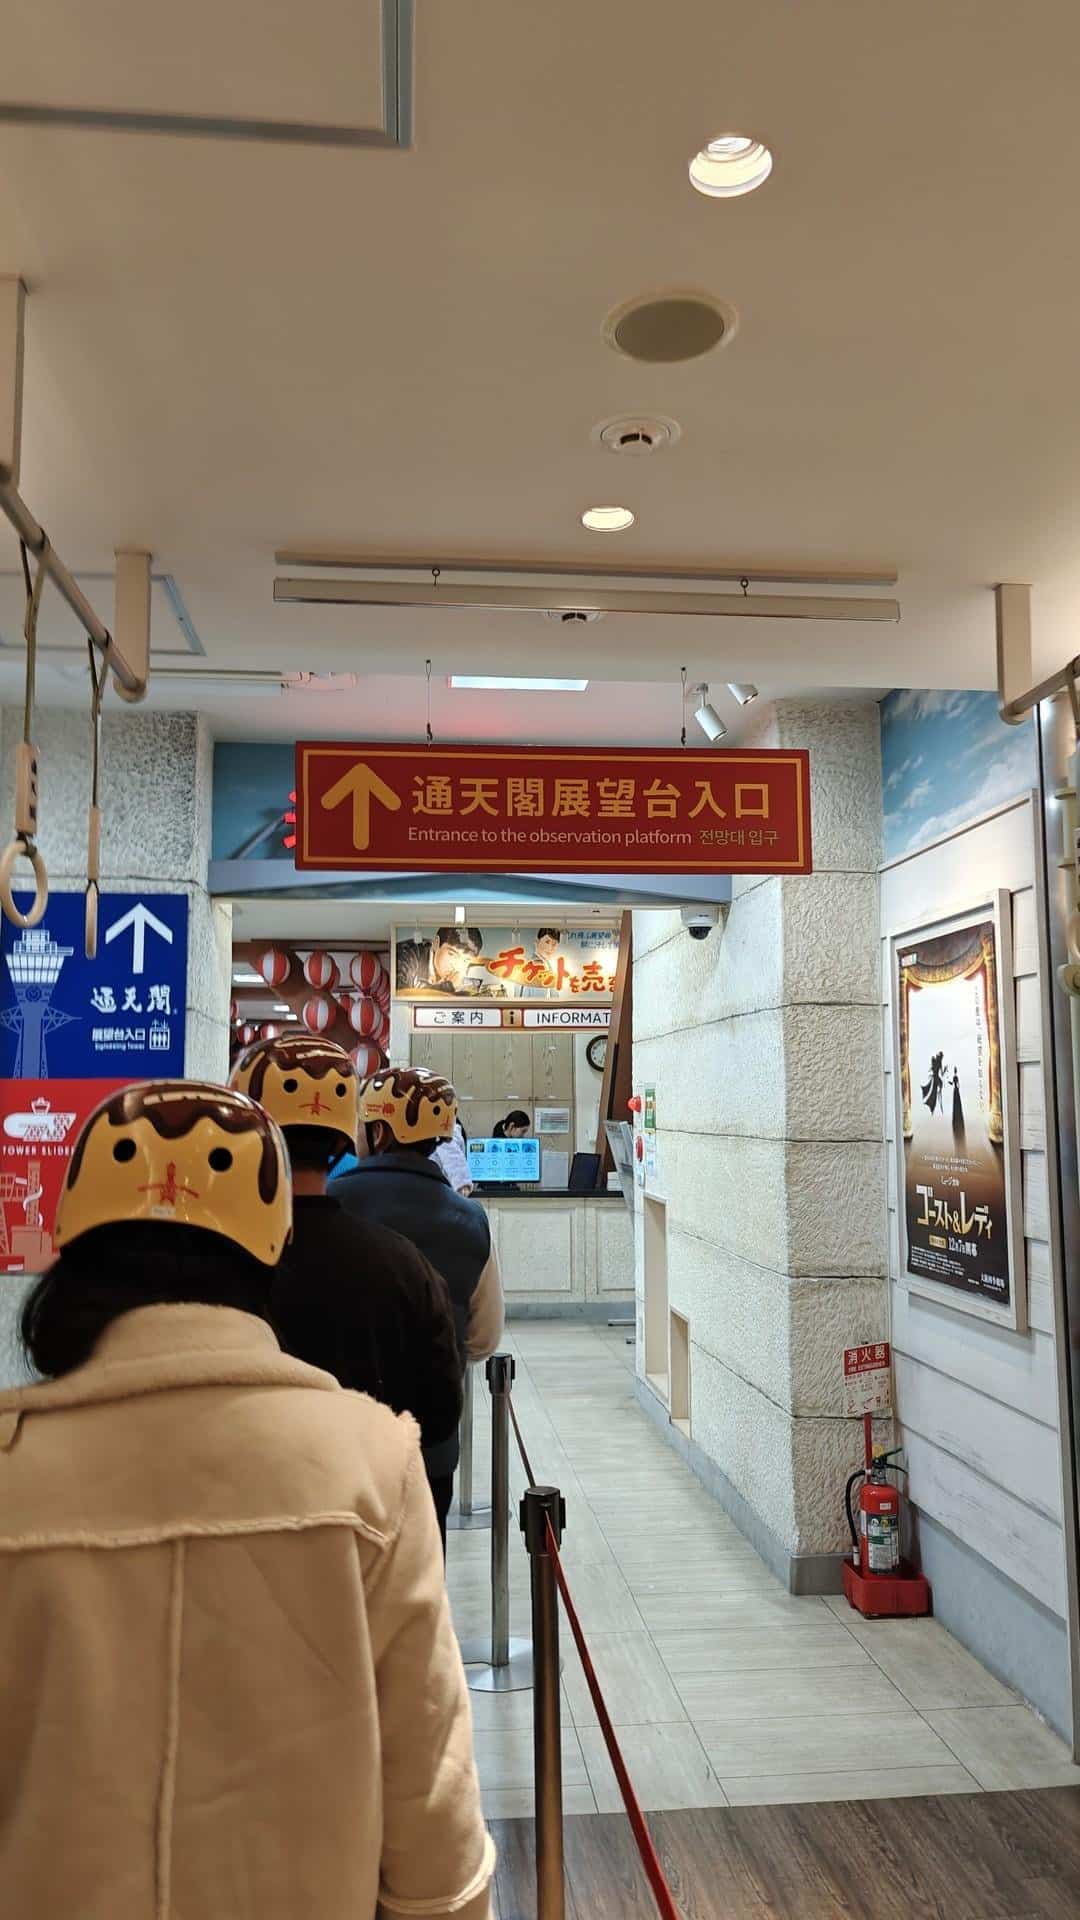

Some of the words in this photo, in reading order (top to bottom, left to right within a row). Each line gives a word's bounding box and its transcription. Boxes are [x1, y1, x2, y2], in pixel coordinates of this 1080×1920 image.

[412, 775, 769, 819] 通天閣展望台入口
[408, 827, 479, 842] Entrance
[482, 829, 497, 843] to
[501, 828, 527, 843] the
[529, 828, 622, 844] observation
[625, 828, 692, 847] platform
[699, 829, 745, 846] 전망대
[748, 829, 780, 847] 입구
[434, 1011, 484, 1025] ご案内
[3, 1145, 37, 1156] TOWER
[916, 1184, 993, 1240] ゴースト&レディ
